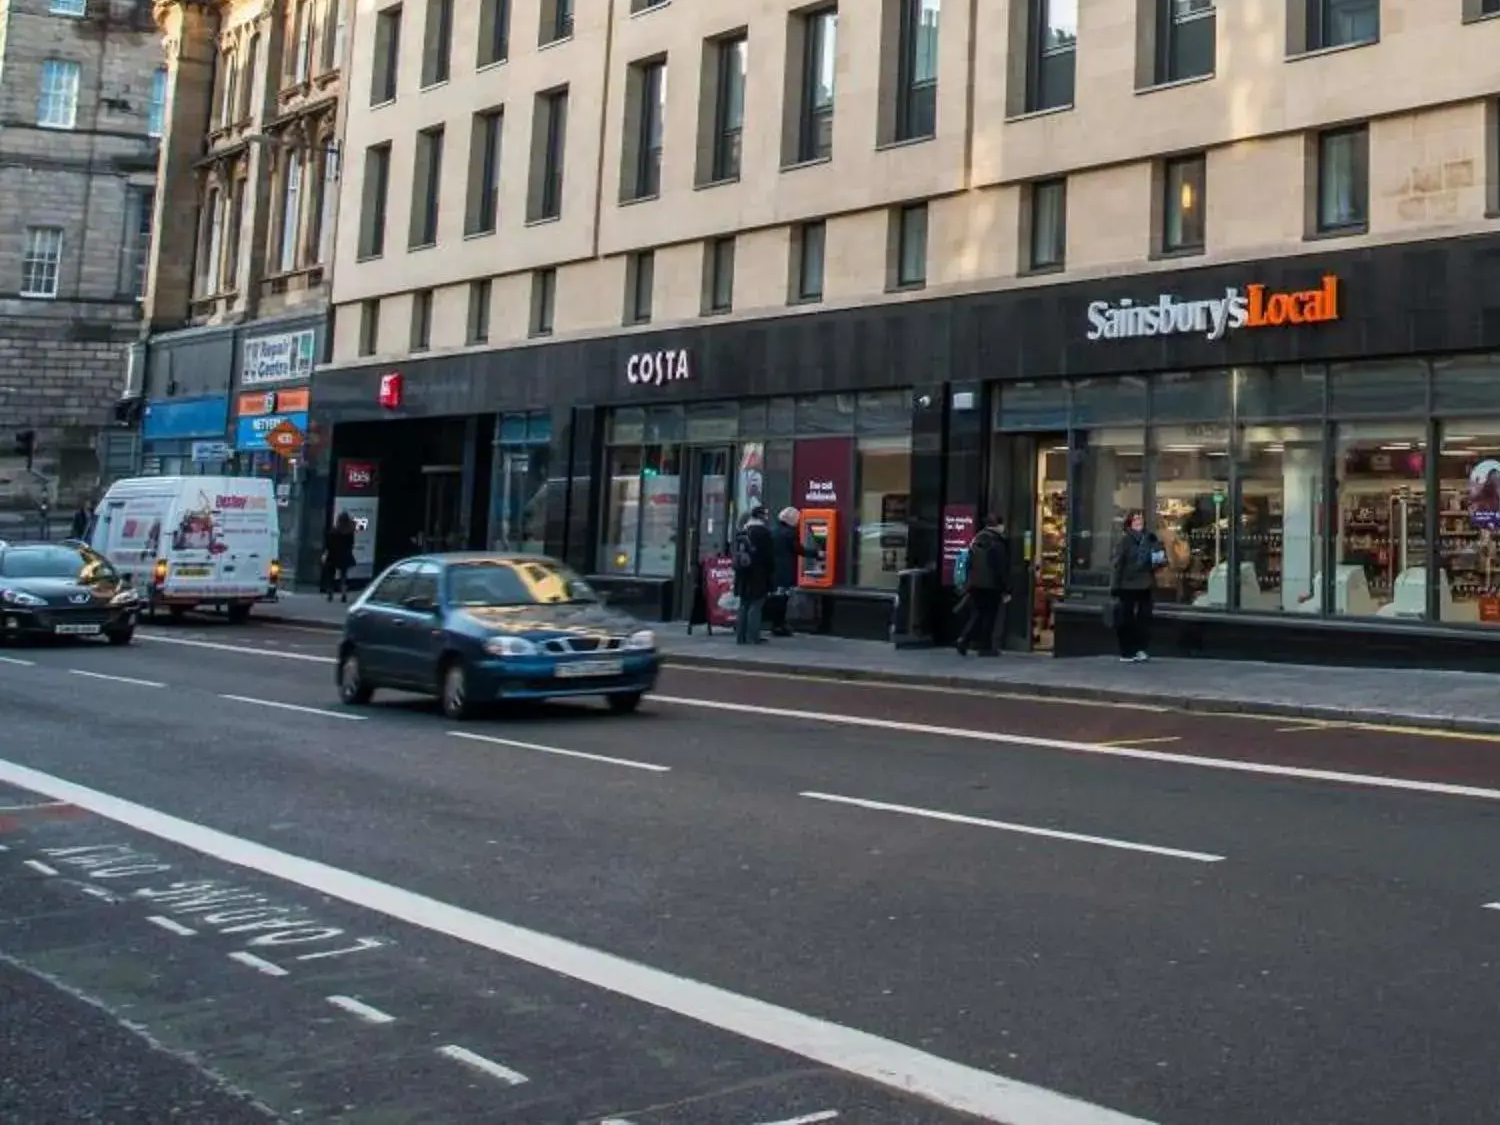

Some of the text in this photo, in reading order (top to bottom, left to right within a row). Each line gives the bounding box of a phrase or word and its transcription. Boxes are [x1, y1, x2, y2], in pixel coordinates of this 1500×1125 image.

[1087, 273, 1338, 340] Sainsbury's Local
[627, 348, 689, 386] COSTA
